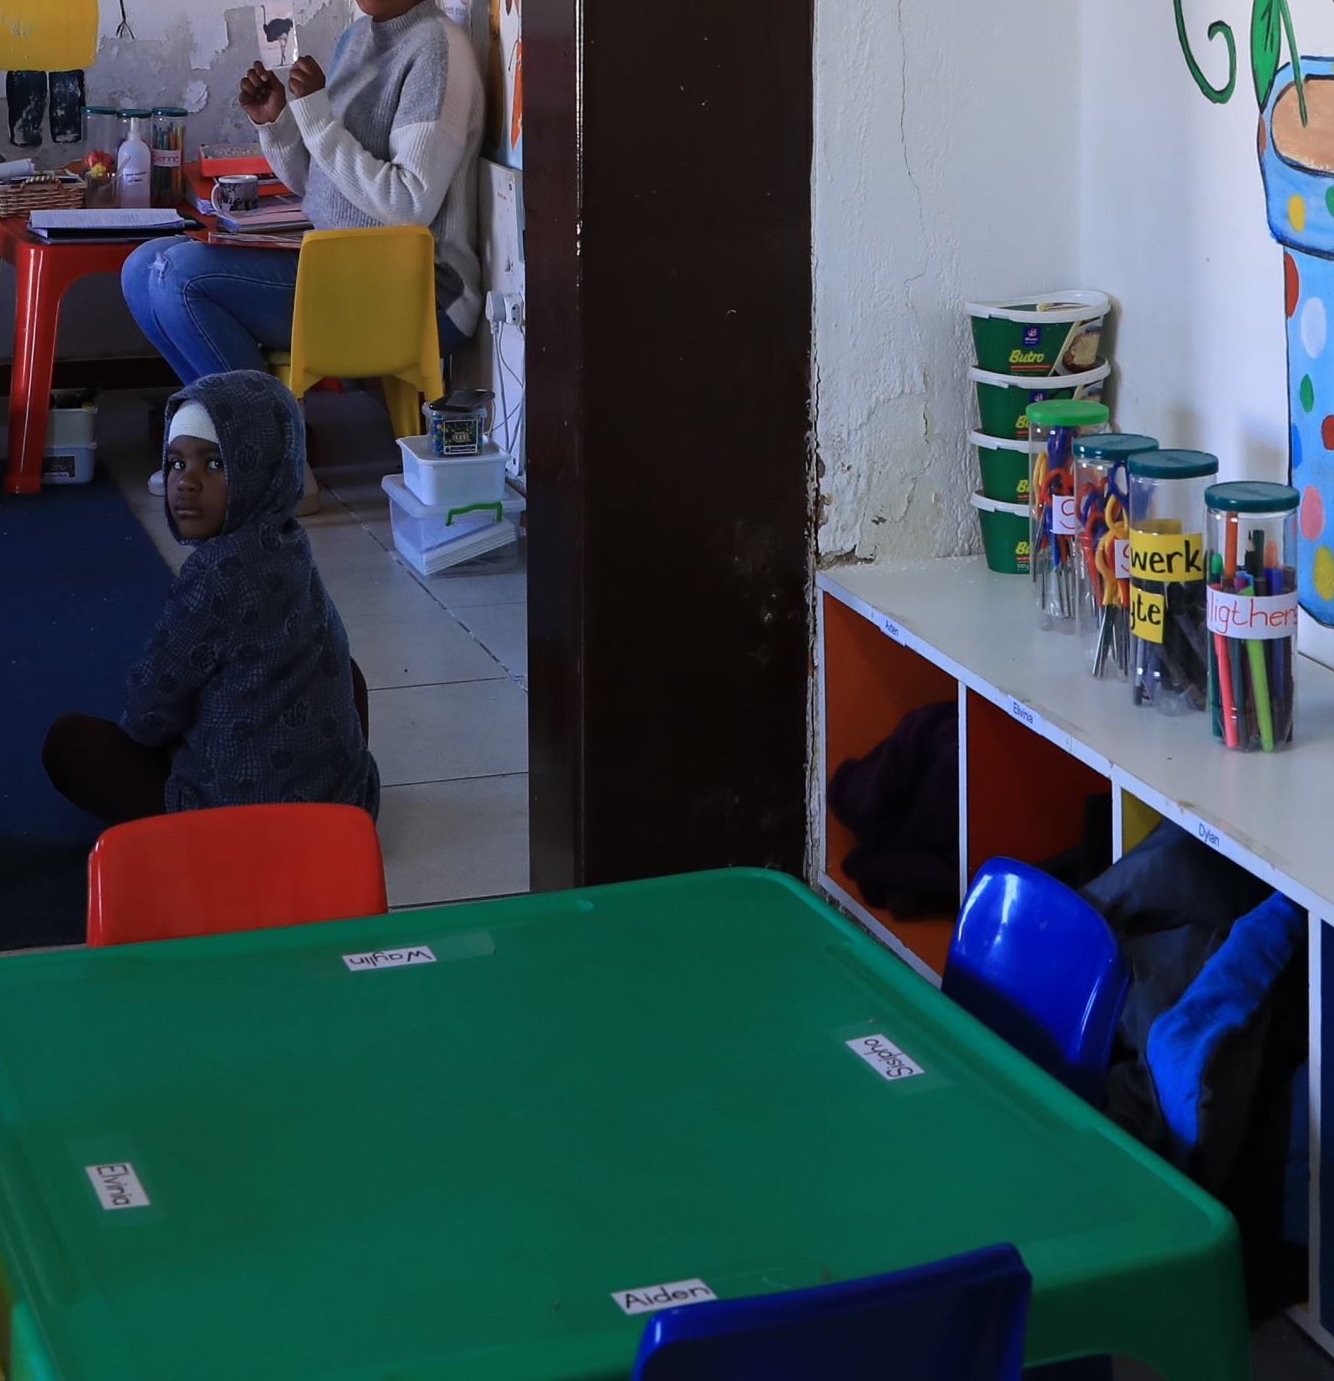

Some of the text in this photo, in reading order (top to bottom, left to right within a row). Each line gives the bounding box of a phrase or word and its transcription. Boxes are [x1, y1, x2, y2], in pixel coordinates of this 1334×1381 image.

[1009, 350, 1044, 363] Butro
[1198, 823, 1220, 846] Dylan
[349, 950, 432, 966] Waylin
[864, 1039, 913, 1077] Sisipho
[97, 1164, 132, 1205] Elvinia
[625, 1286, 710, 1309] Aiden
